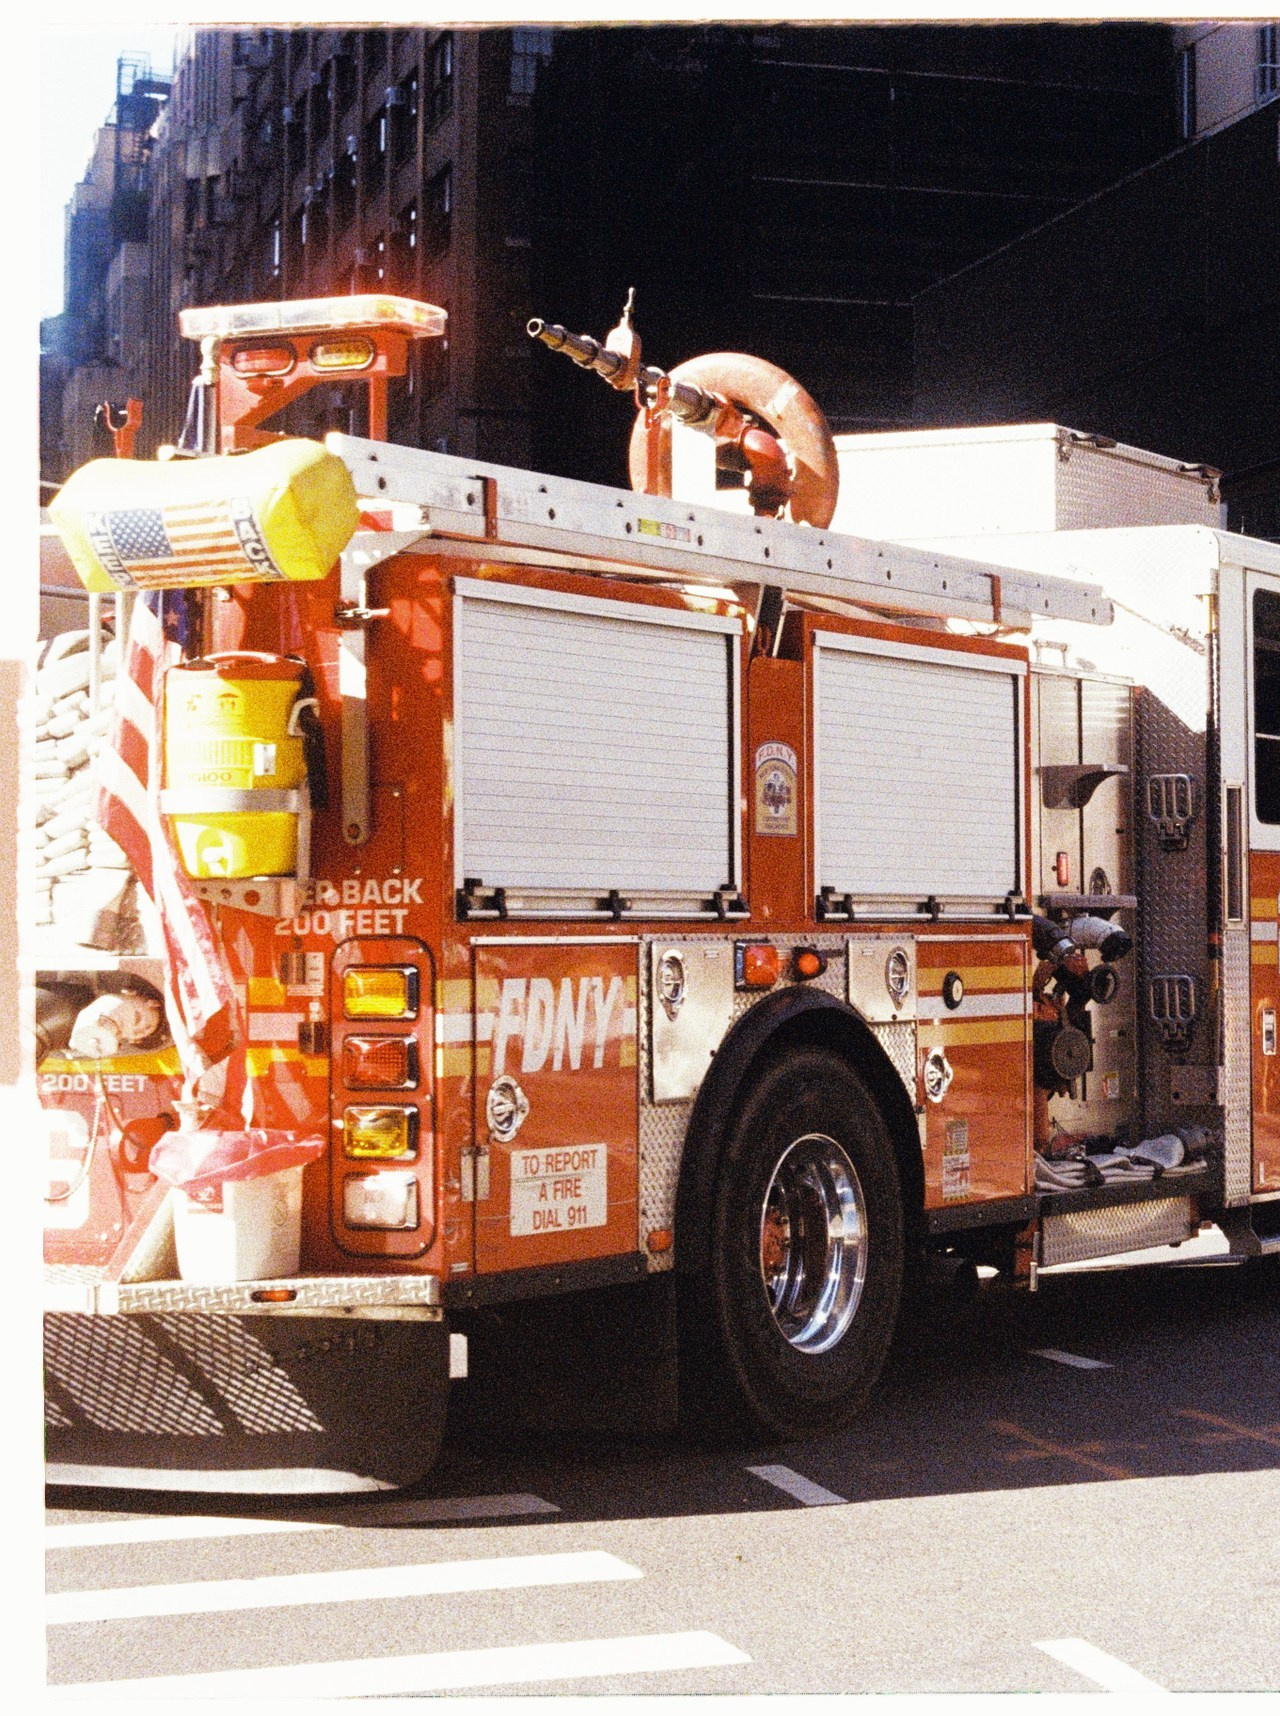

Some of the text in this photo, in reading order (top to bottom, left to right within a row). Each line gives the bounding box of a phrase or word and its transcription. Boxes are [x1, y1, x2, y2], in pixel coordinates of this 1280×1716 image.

[232, 499, 278, 580] BACK
[342, 877, 424, 905] BACK
[274, 908, 408, 936] 200 FEET
[493, 975, 619, 1076] FDNY
[42, 1073, 87, 1093] 200
[521, 1149, 599, 1176] TO REPORT
[538, 1178, 583, 1202] A FIRE
[532, 1206, 588, 1231] DIAL 911
